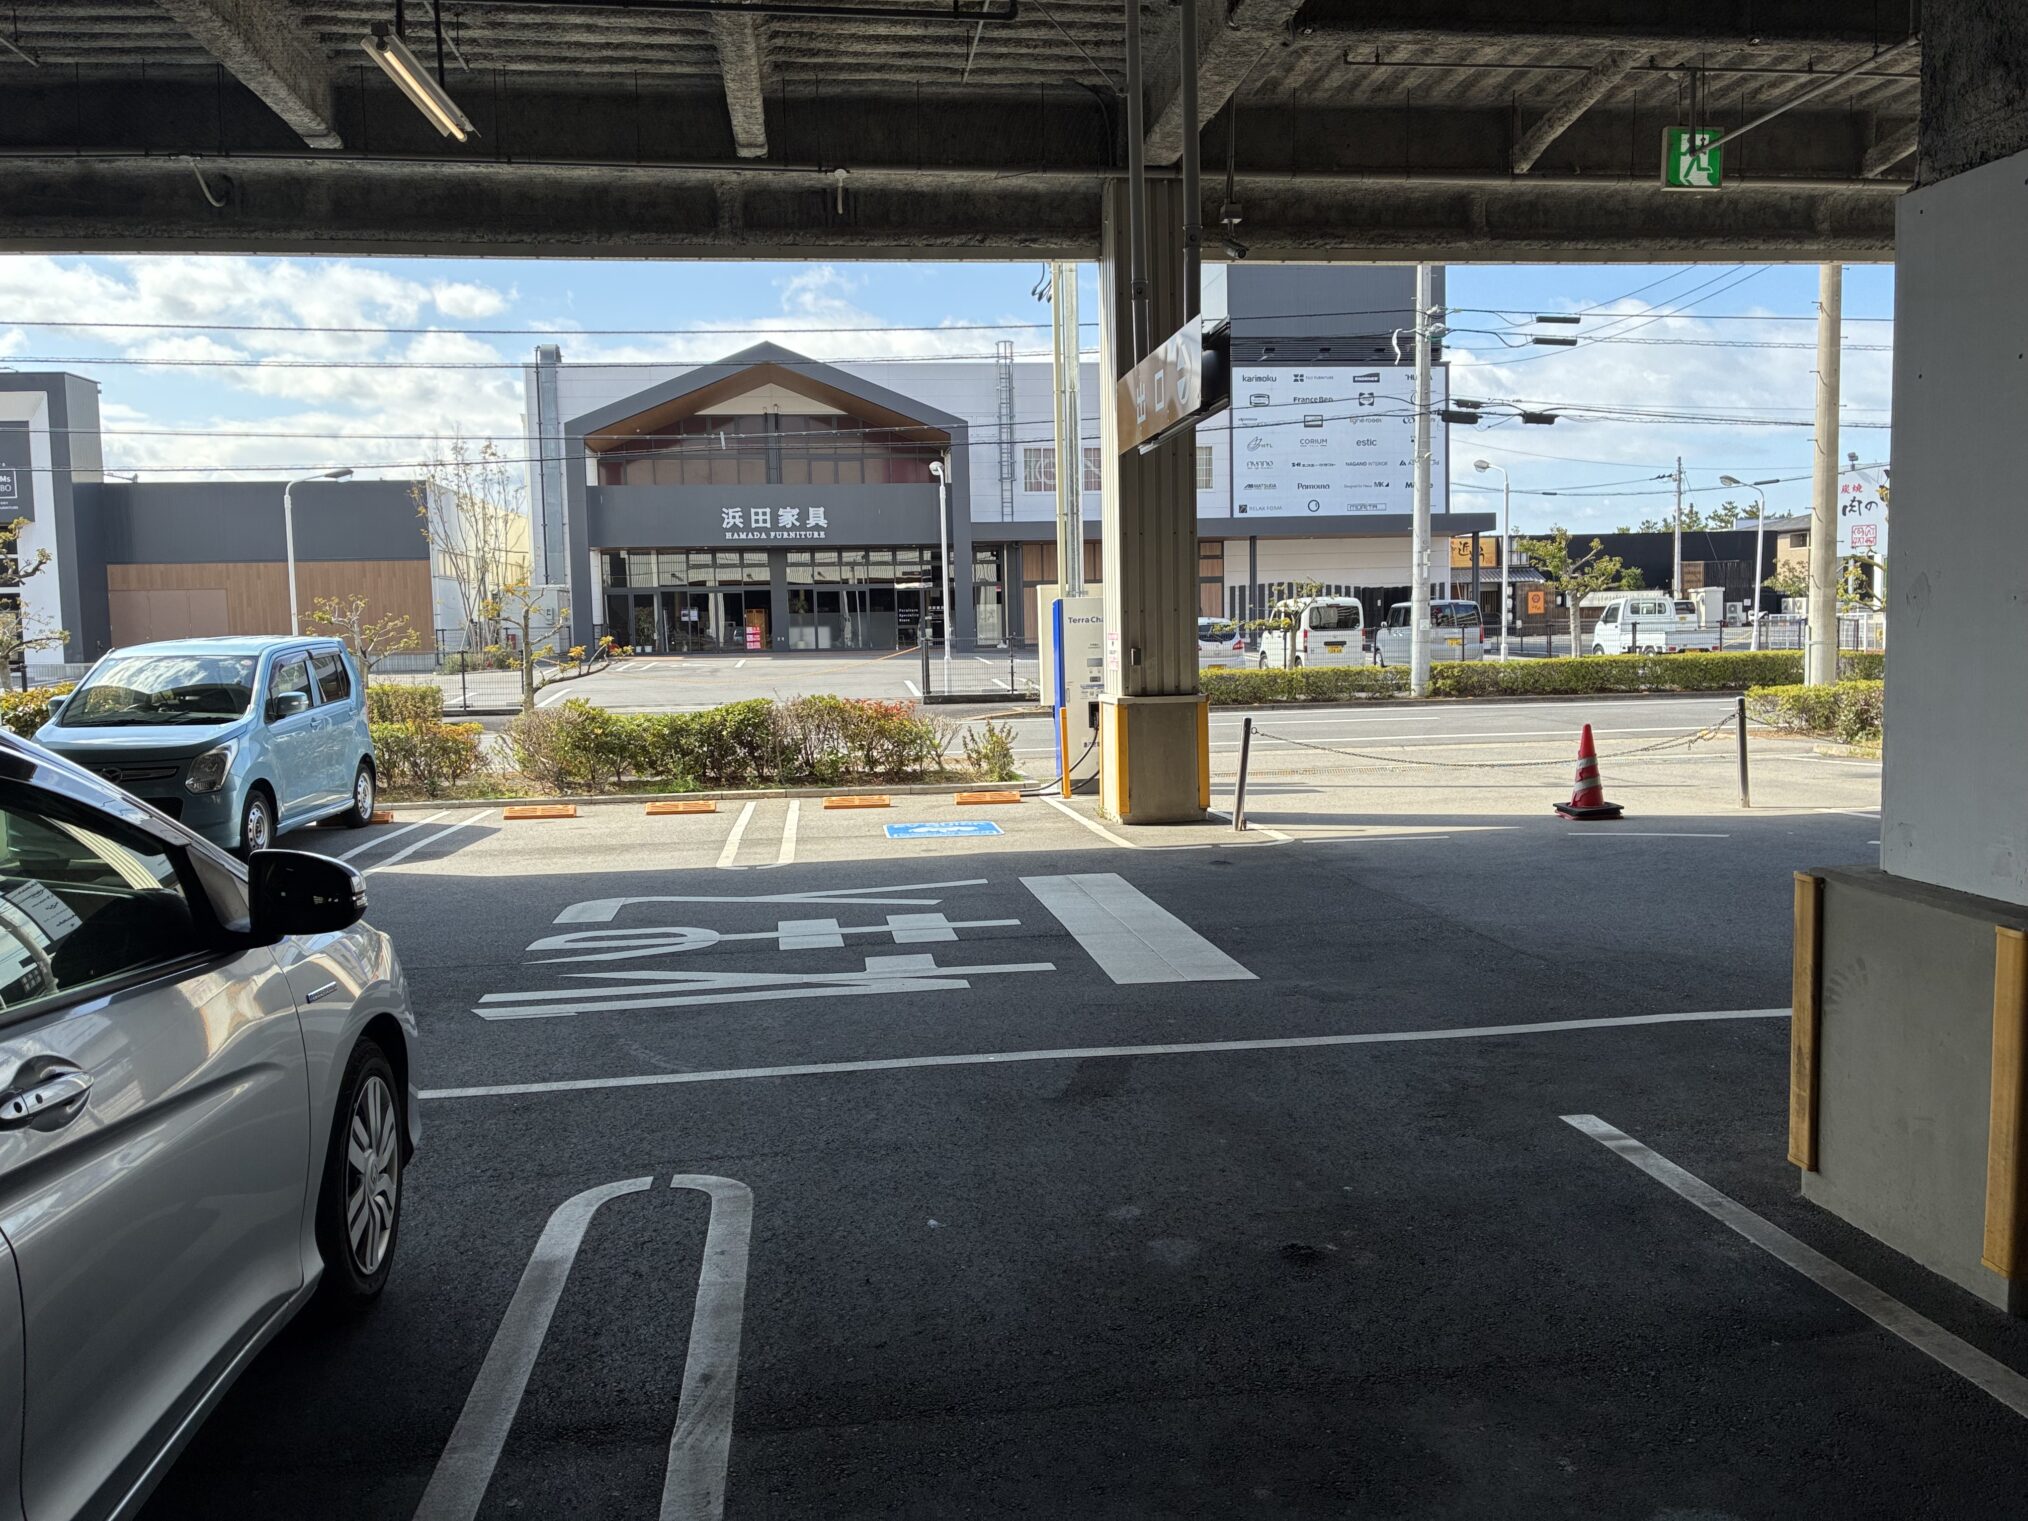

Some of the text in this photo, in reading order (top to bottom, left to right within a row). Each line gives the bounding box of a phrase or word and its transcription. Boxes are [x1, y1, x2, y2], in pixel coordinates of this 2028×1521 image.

[1242, 374, 1277, 382] karimoku
[1136, 368, 1166, 425] 出口
[1356, 438, 1377, 446] estic
[721, 506, 828, 529] 浜田家具
[725, 531, 826, 540] HAMADA FURNITURE
